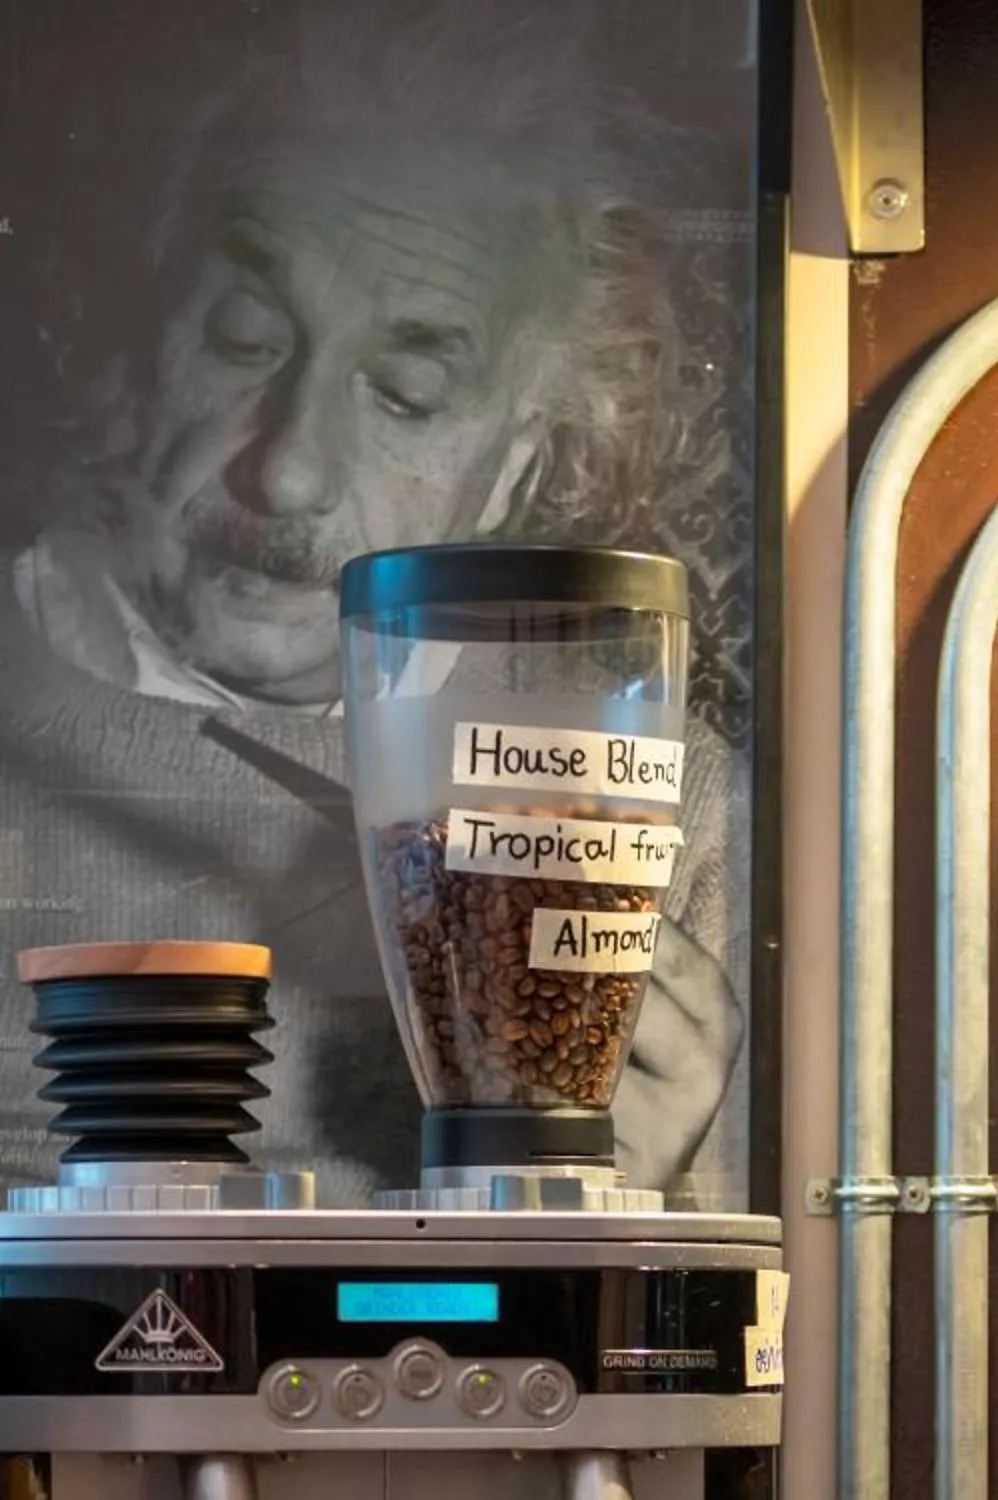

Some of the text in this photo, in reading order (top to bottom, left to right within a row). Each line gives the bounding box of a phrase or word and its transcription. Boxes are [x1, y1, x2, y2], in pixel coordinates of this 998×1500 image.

[469, 727, 679, 789] House Blend
[463, 817, 617, 870] Tropical
[553, 914, 662, 959] Almond
[602, 1354, 646, 1369] GRIND
[648, 1354, 668, 1369] ON
